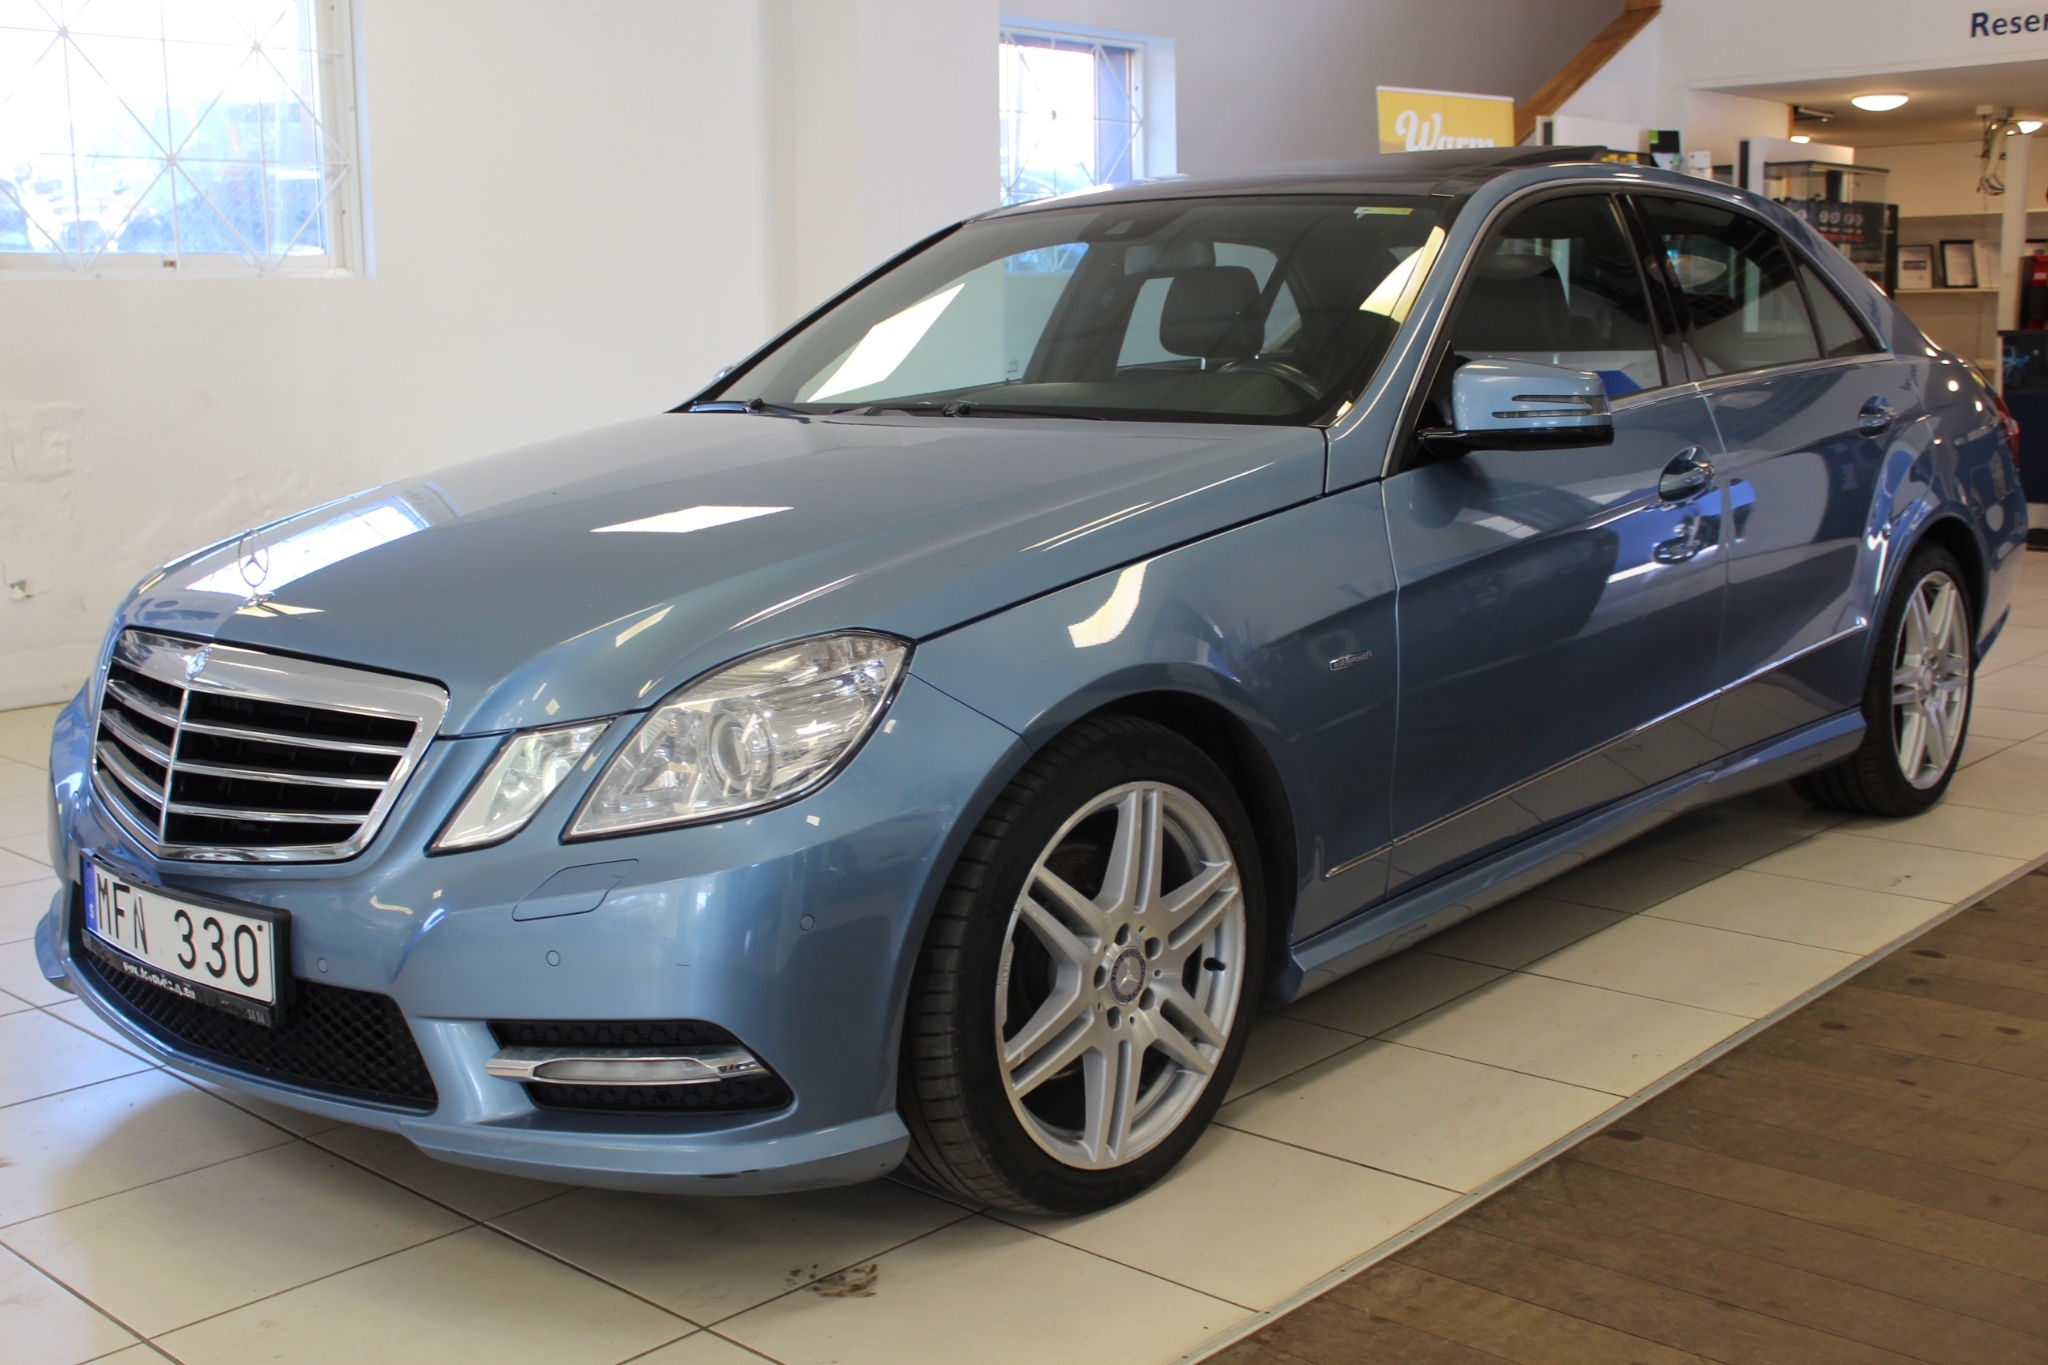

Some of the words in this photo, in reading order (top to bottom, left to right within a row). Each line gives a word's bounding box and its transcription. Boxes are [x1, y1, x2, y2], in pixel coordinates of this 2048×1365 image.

[88, 903, 95, 919] S
[97, 873, 148, 955] MFN
[174, 909, 260, 987] 330
